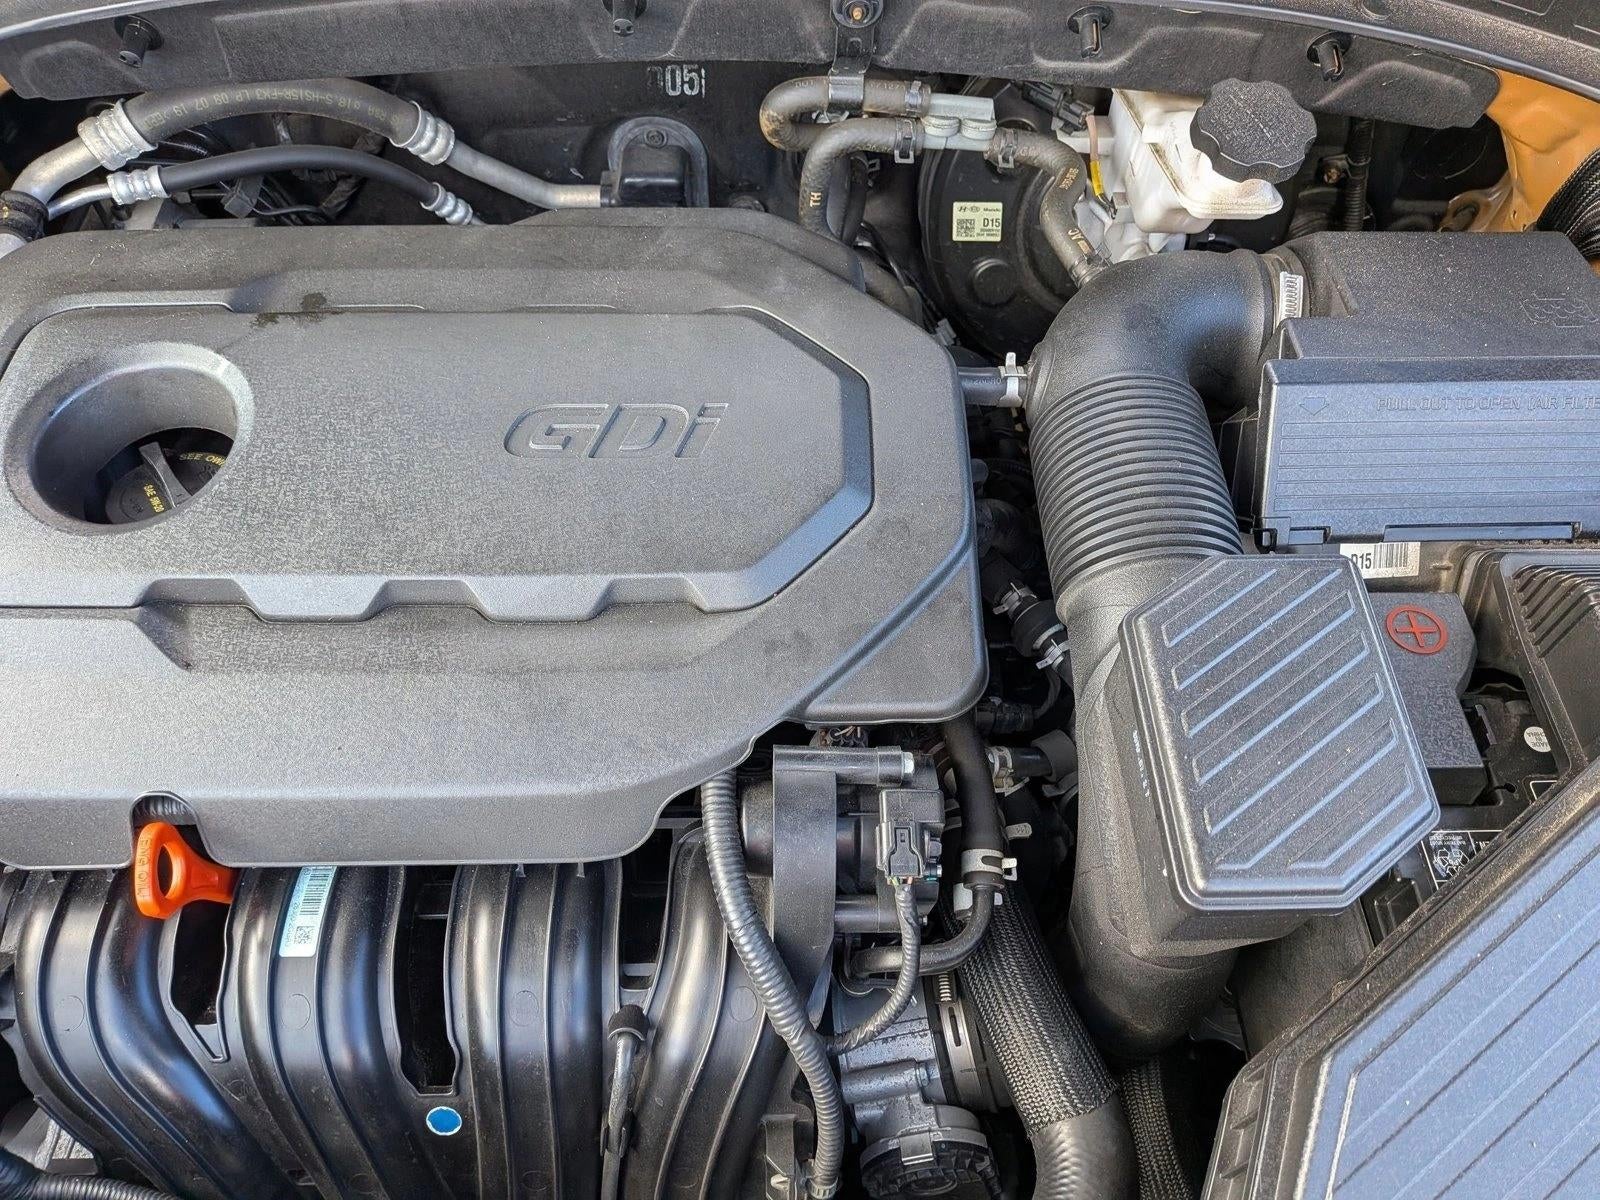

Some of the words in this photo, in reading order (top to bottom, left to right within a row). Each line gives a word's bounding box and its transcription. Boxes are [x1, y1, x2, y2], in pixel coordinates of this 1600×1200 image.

[809, 191, 822, 208] TH
[982, 217, 1001, 228] D15
[1455, 398, 1475, 411] TO
[179, 452, 203, 461] SEE
